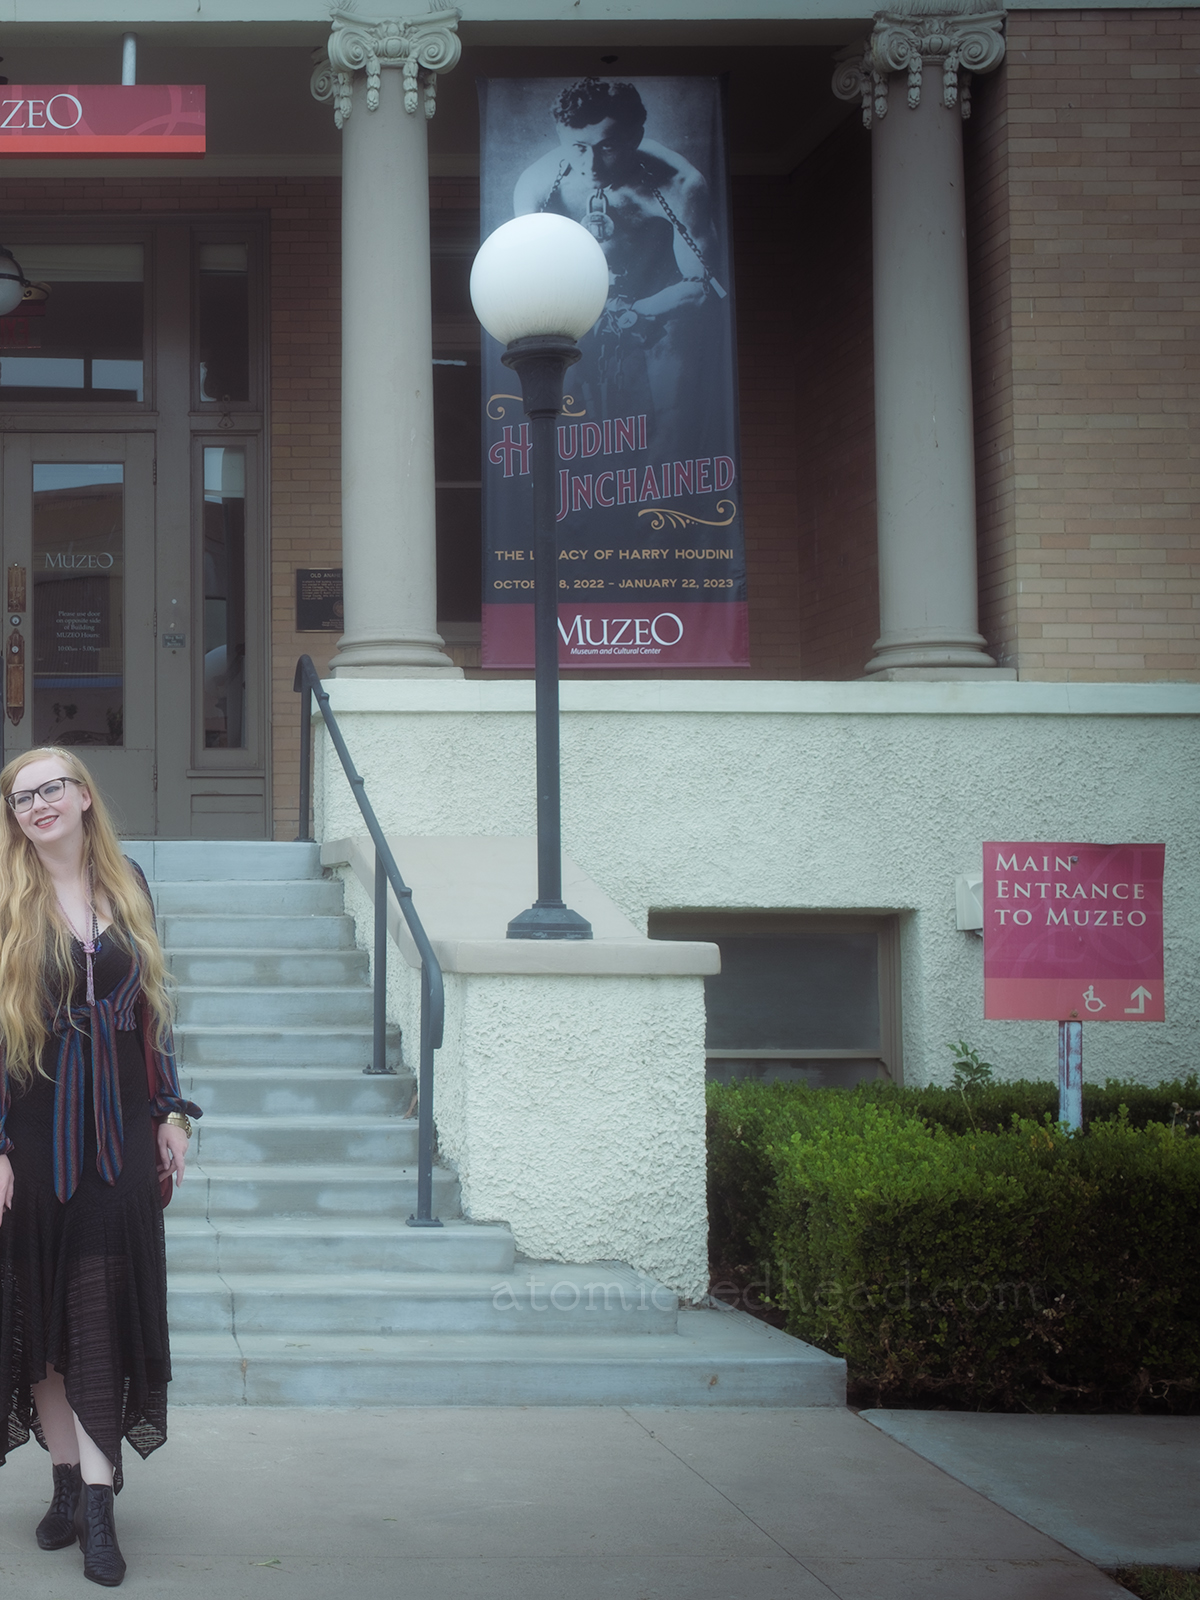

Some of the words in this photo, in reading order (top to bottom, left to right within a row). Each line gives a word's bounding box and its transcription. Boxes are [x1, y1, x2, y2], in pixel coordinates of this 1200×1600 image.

[488, 414, 648, 478] HUDINI
[44, 552, 114, 569] MUZEO
[494, 550, 525, 561] THE
[529, 549, 589, 561] LACY
[593, 549, 614, 560] OF
[619, 548, 669, 560] HARRY
[675, 548, 734, 560] HOUDINI
[493, 580, 535, 590] OCTO
[558, 579, 570, 590] 8,
[573, 579, 605, 589] 2022
[618, 579, 678, 588] JANUARY
[681, 579, 700, 590] 22,
[703, 578, 734, 588] 2023
[570, 647, 599, 655] Museum
[599, 647, 612, 655] and
[613, 647, 639, 655] Cultural
[639, 647, 662, 655] Center
[994, 853, 1074, 872] MAIN
[996, 880, 1145, 899] ENTRANCE
[994, 909, 1033, 926] TO
[1045, 907, 1147, 927] MUZEO
